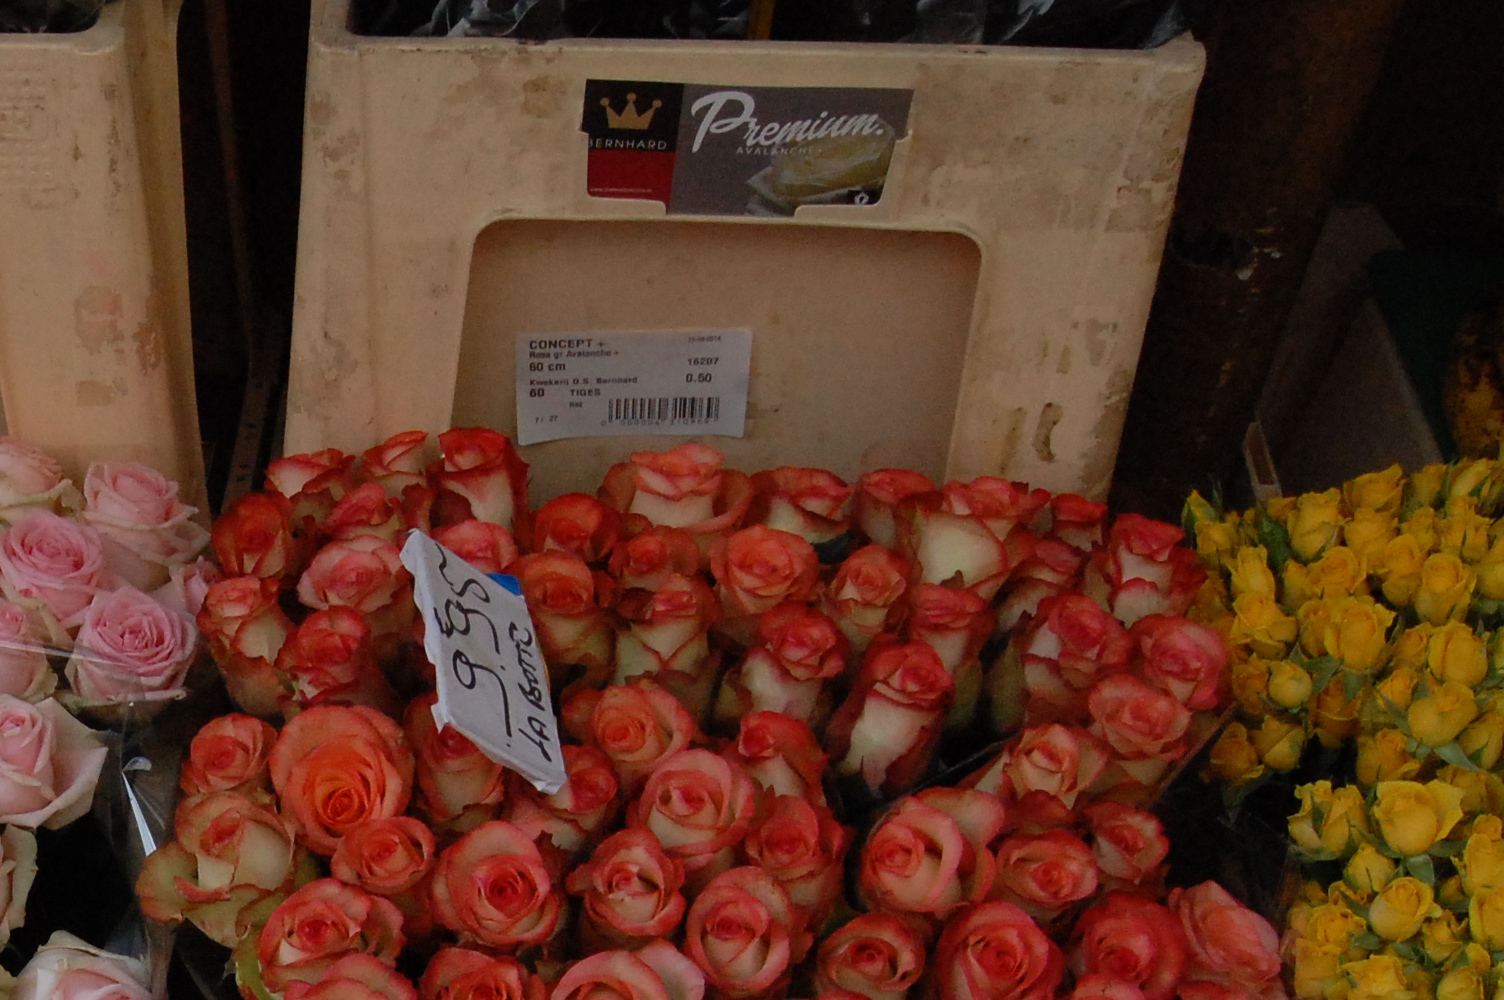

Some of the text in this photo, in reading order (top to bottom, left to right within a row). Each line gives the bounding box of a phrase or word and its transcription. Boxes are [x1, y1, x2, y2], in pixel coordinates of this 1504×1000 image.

[529, 339, 593, 350] CONCEPT
[529, 351, 551, 359] Rosa
[566, 349, 612, 358] Avalanche
[687, 357, 719, 366] 16207
[529, 362, 566, 372] 60 cm
[685, 373, 712, 383] 0.50
[529, 388, 601, 398] 60 TIGES
